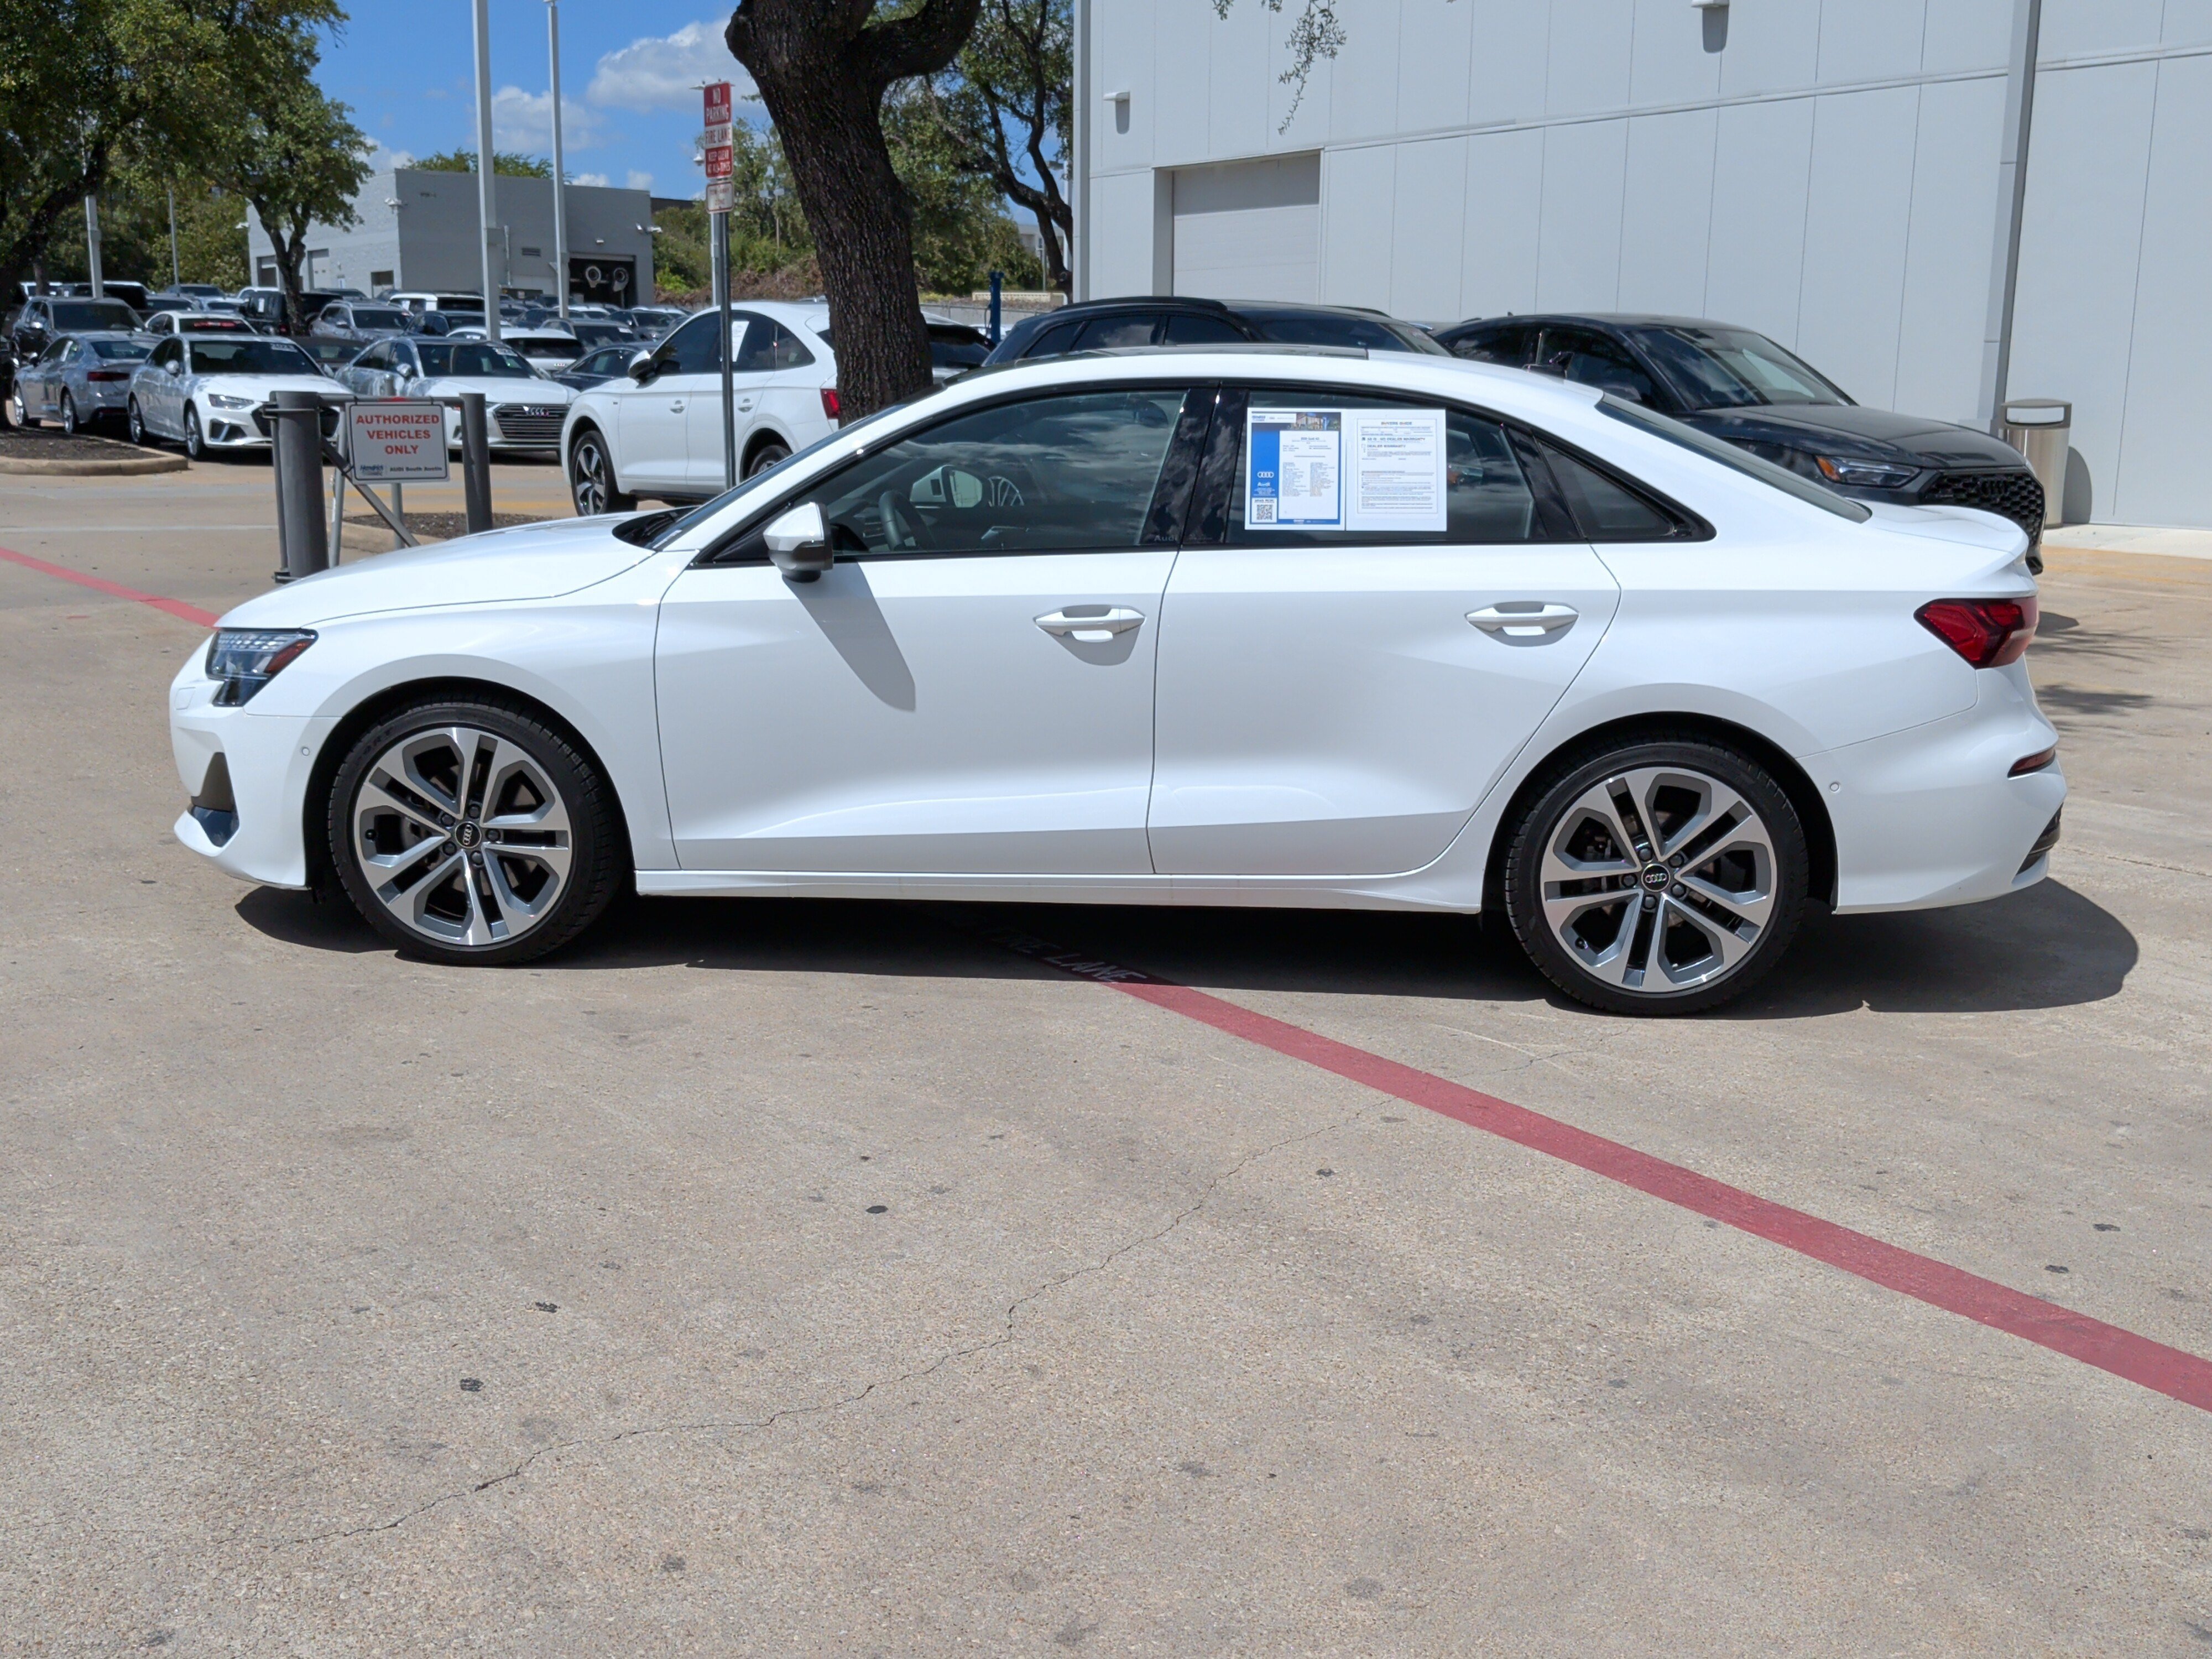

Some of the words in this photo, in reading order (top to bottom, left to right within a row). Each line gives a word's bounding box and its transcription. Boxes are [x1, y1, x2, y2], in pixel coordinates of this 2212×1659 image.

[713, 87, 721, 104] NO
[706, 103, 729, 123] PARKING
[705, 128, 716, 144] FIRE
[718, 127, 731, 143] LANE
[356, 415, 440, 424] AUTHORIZED
[367, 430, 431, 439] VEHICLES
[385, 445, 419, 455] ONLY
